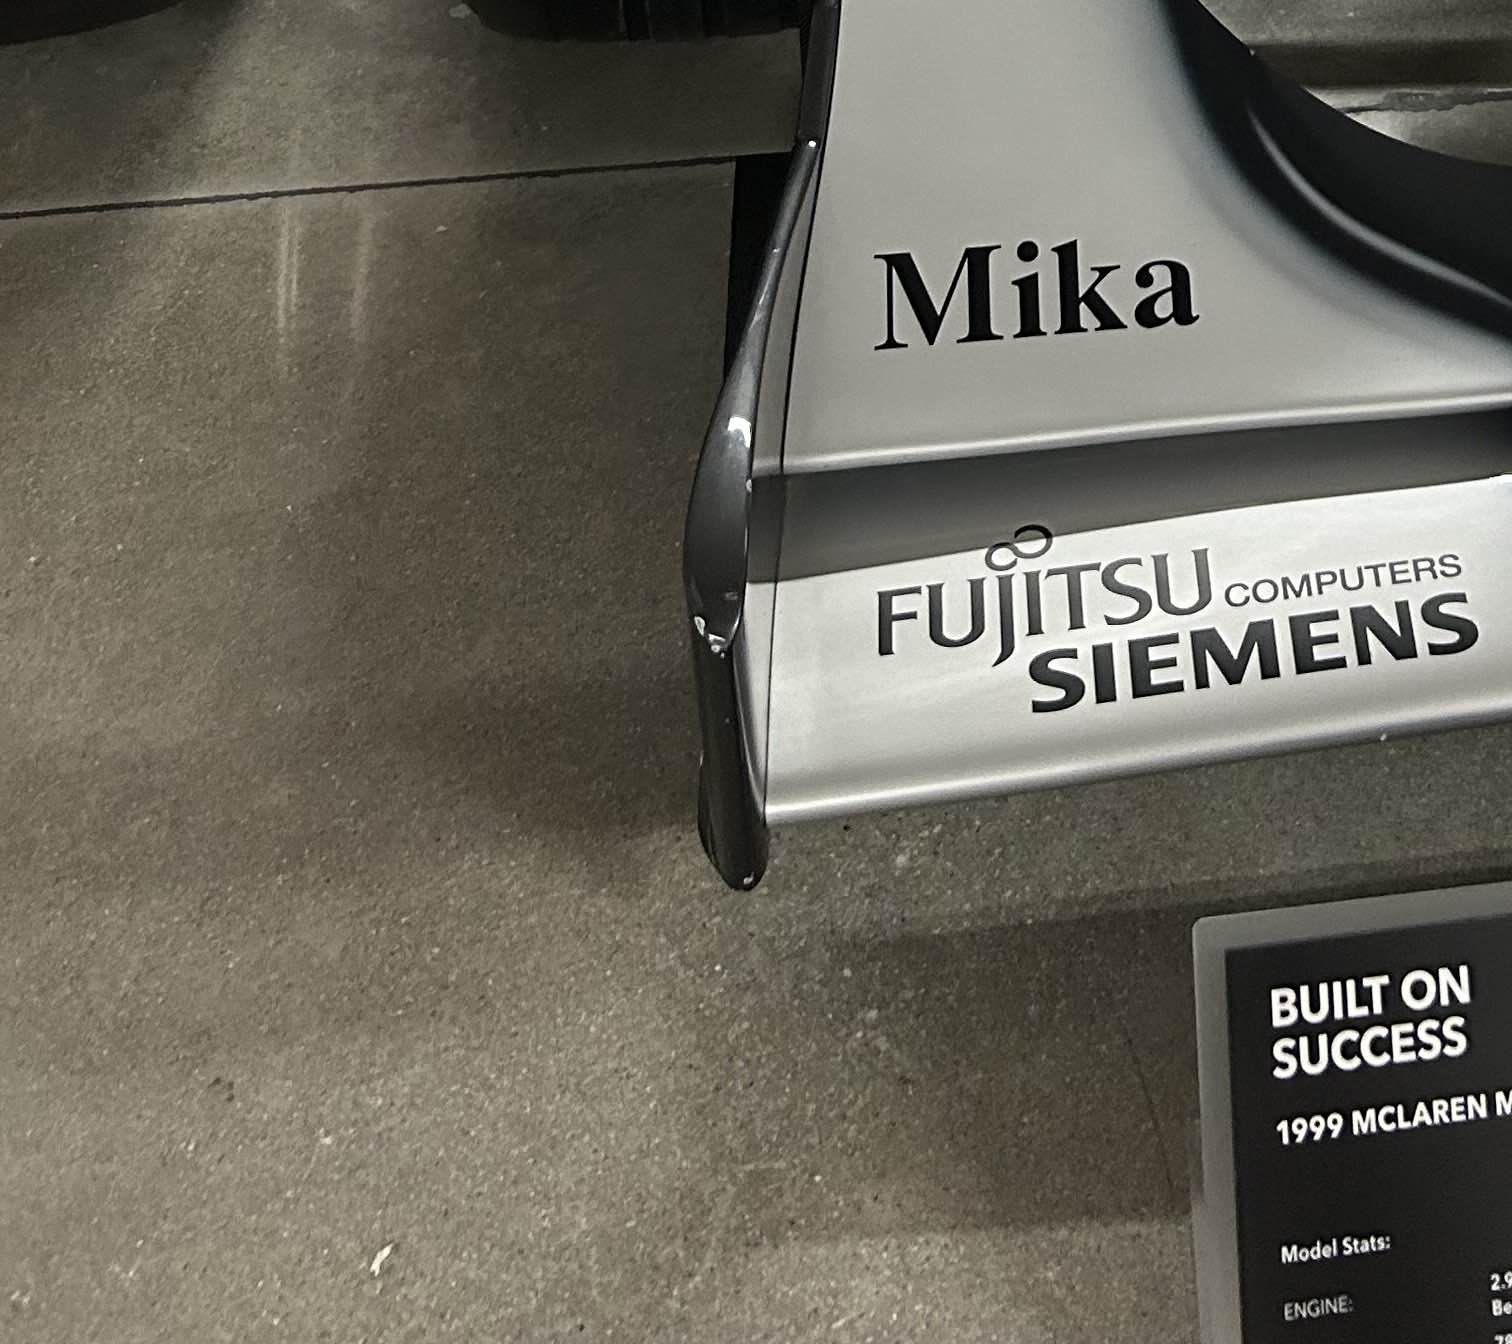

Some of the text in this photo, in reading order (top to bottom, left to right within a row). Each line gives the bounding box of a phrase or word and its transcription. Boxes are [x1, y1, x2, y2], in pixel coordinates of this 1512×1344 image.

[873, 238, 1200, 352] Mika
[876, 524, 1463, 668] FUJITSU COMPUTERS
[1029, 591, 1480, 714] SIEMENS
[1269, 964, 1472, 1028] BUILT ON
[1272, 1015, 1467, 1079] SUCCESS
[1276, 1112, 1344, 1145] 1999
[1351, 1093, 1487, 1137] MCLAREN
[1281, 1234, 1391, 1263] Model Stats:
[1284, 1294, 1353, 1321] ENGINE:
